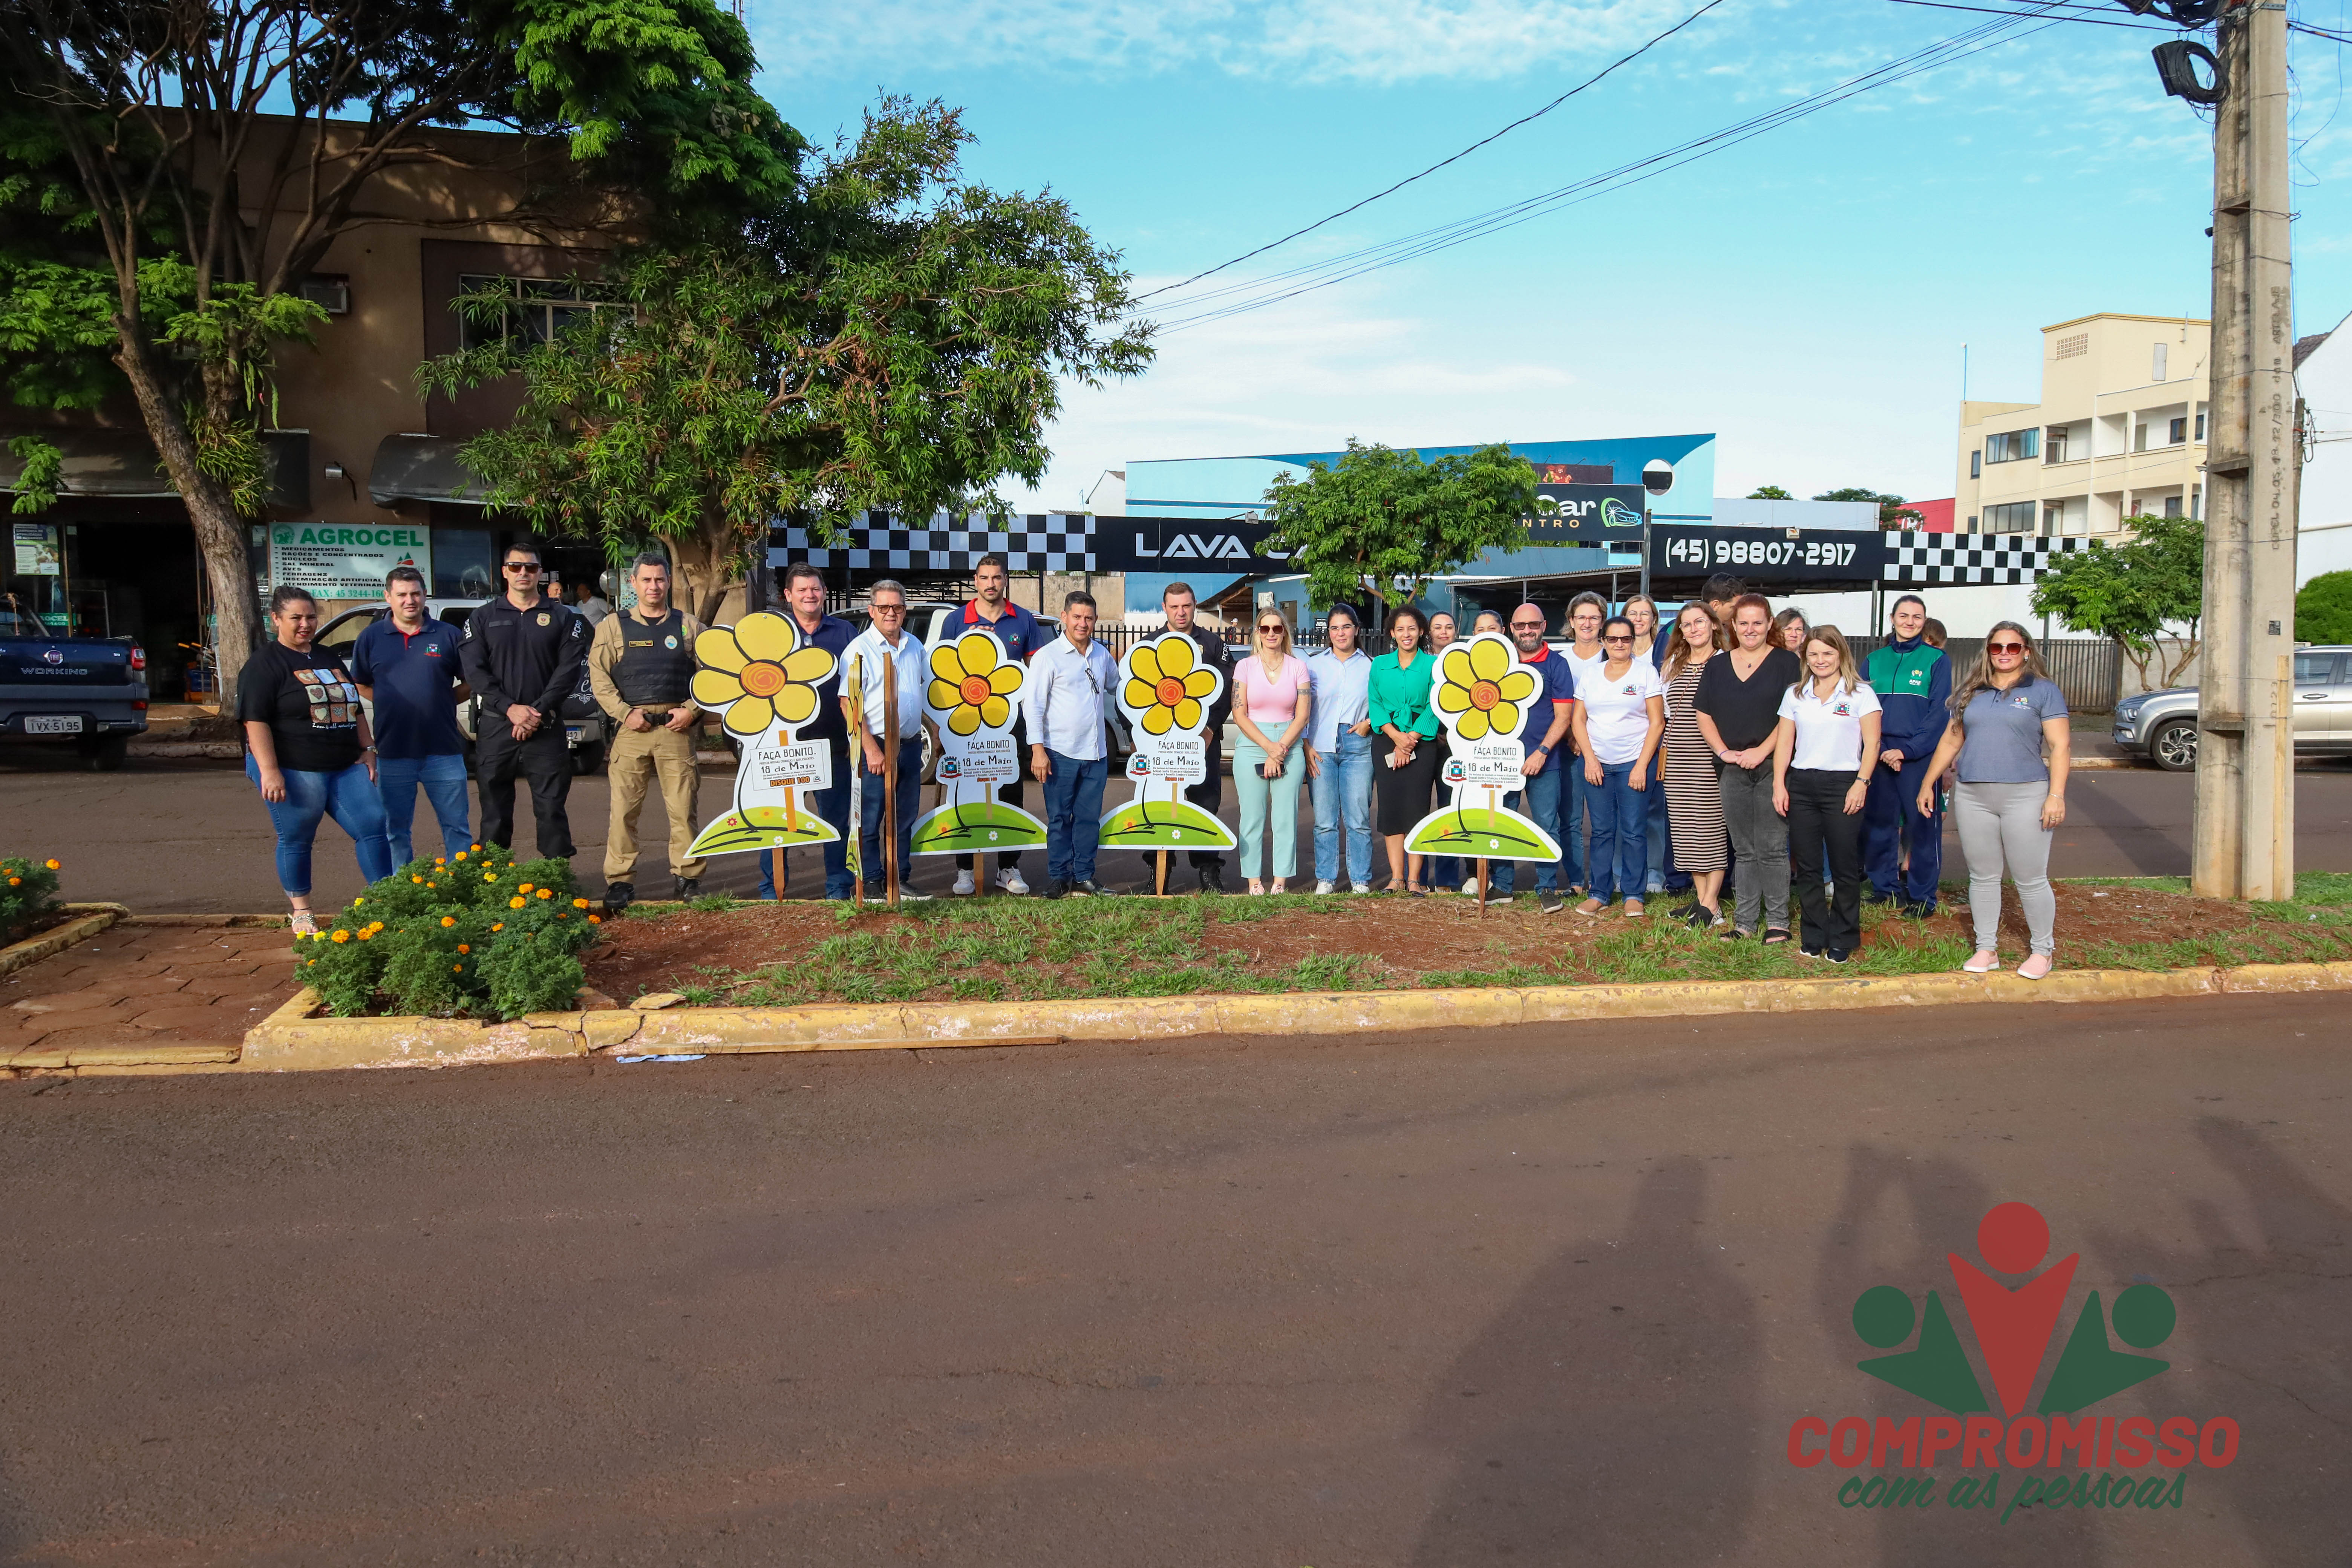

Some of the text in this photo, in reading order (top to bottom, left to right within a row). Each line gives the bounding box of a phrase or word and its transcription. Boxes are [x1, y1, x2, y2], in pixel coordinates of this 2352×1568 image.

[1513, 519, 1580, 528] NTRO
[299, 528, 424, 546] AGROCEL
[1136, 533, 1251, 559] LAVA
[1666, 537, 1856, 568] (45) 98807-2917
[572, 620, 582, 638] PCPR
[968, 740, 1009, 750] FAÇA BONITO
[1158, 741, 1198, 750] FAÇA BONITO
[759, 747, 816, 760] FAÇA BONITO.
[1474, 746, 1516, 756] FAÇA BONITO
[963, 758, 971, 766] 18
[988, 755, 1011, 764] Maio
[1152, 757, 1160, 765] 18
[1177, 756, 1199, 766] Maio
[789, 762, 815, 770] Maio
[1468, 763, 1476, 772] 18
[1494, 762, 1517, 772] Maio
[770, 778, 795, 787] DISQUE
